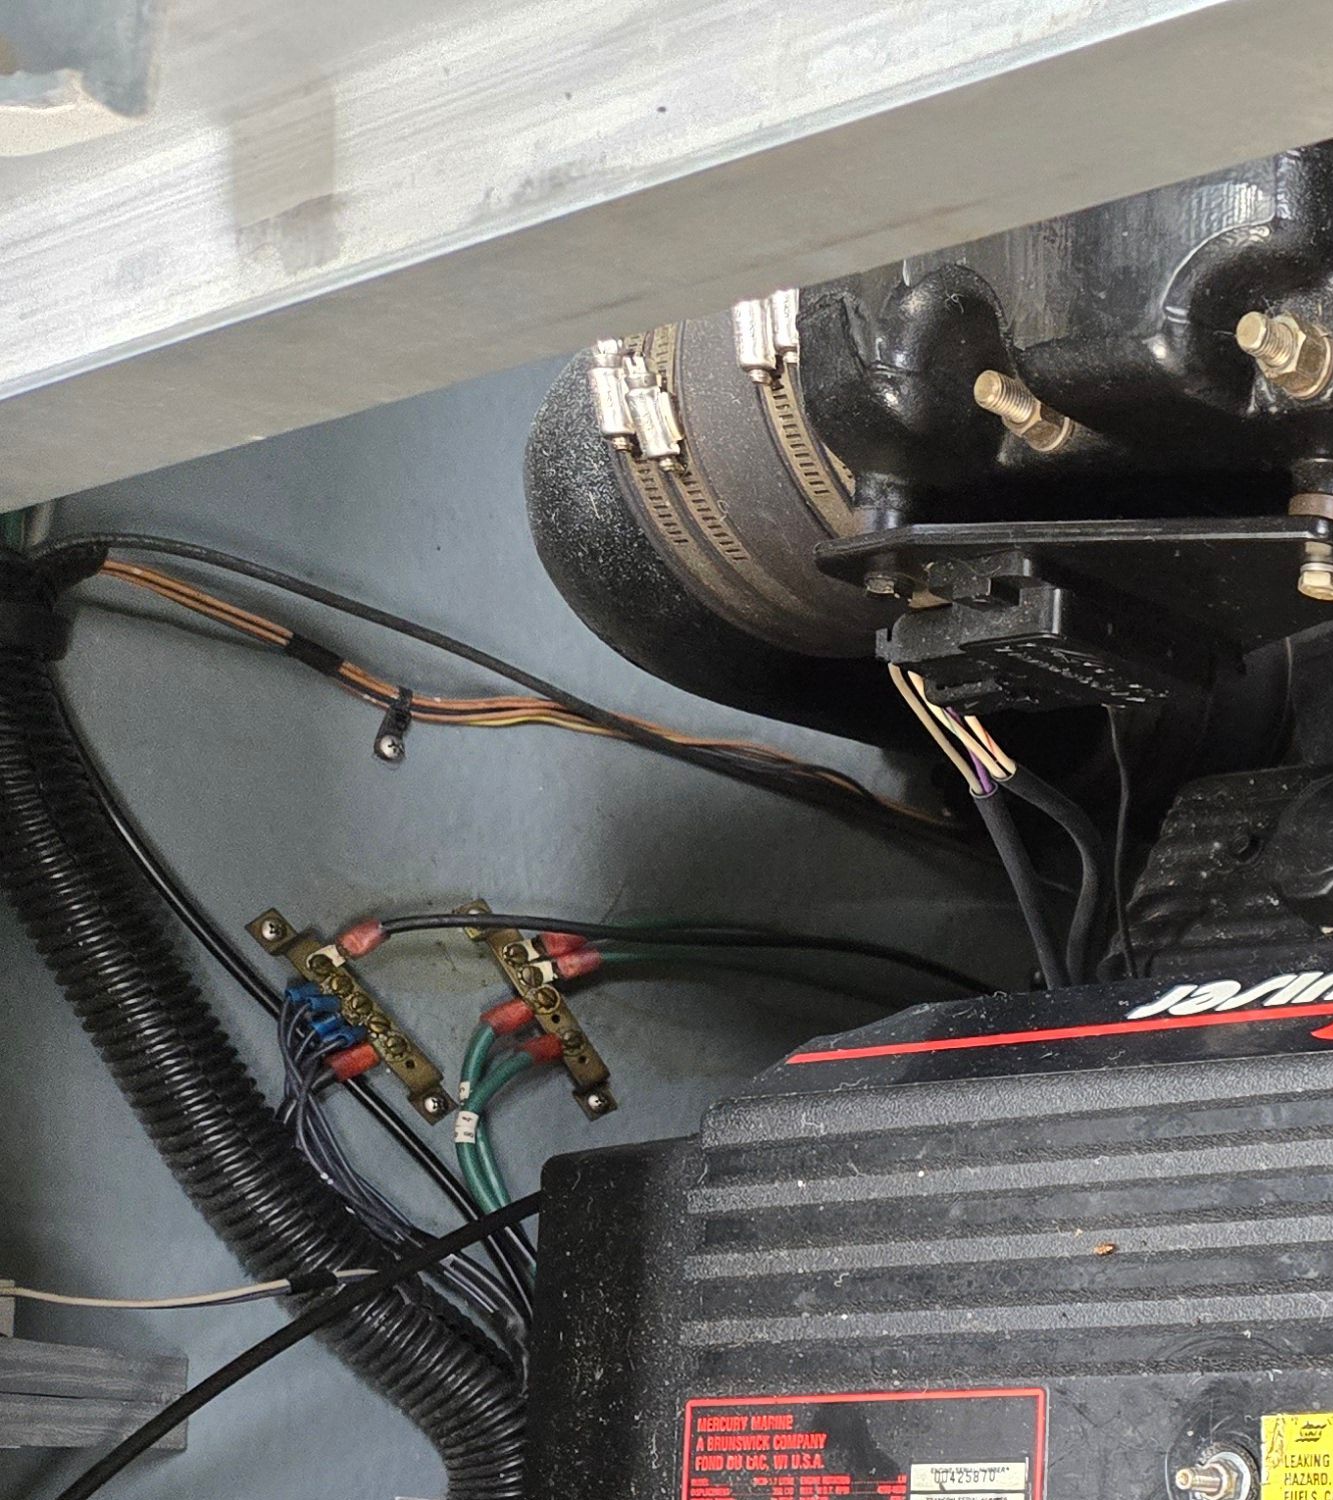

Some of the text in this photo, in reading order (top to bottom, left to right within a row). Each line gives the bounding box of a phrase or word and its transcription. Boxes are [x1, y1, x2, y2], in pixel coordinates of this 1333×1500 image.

[697, 1415, 793, 1432] MERCURY MARINE
[696, 1433, 827, 1452] A BRUNSWICK COMPANY
[695, 1455, 723, 1471] FOND
[774, 1454, 788, 1469] WI
[792, 1454, 824, 1469] U.S.A.
[1284, 1454, 1330, 1468] LEAKING
[1284, 1472, 1332, 1486] HAZARD.
